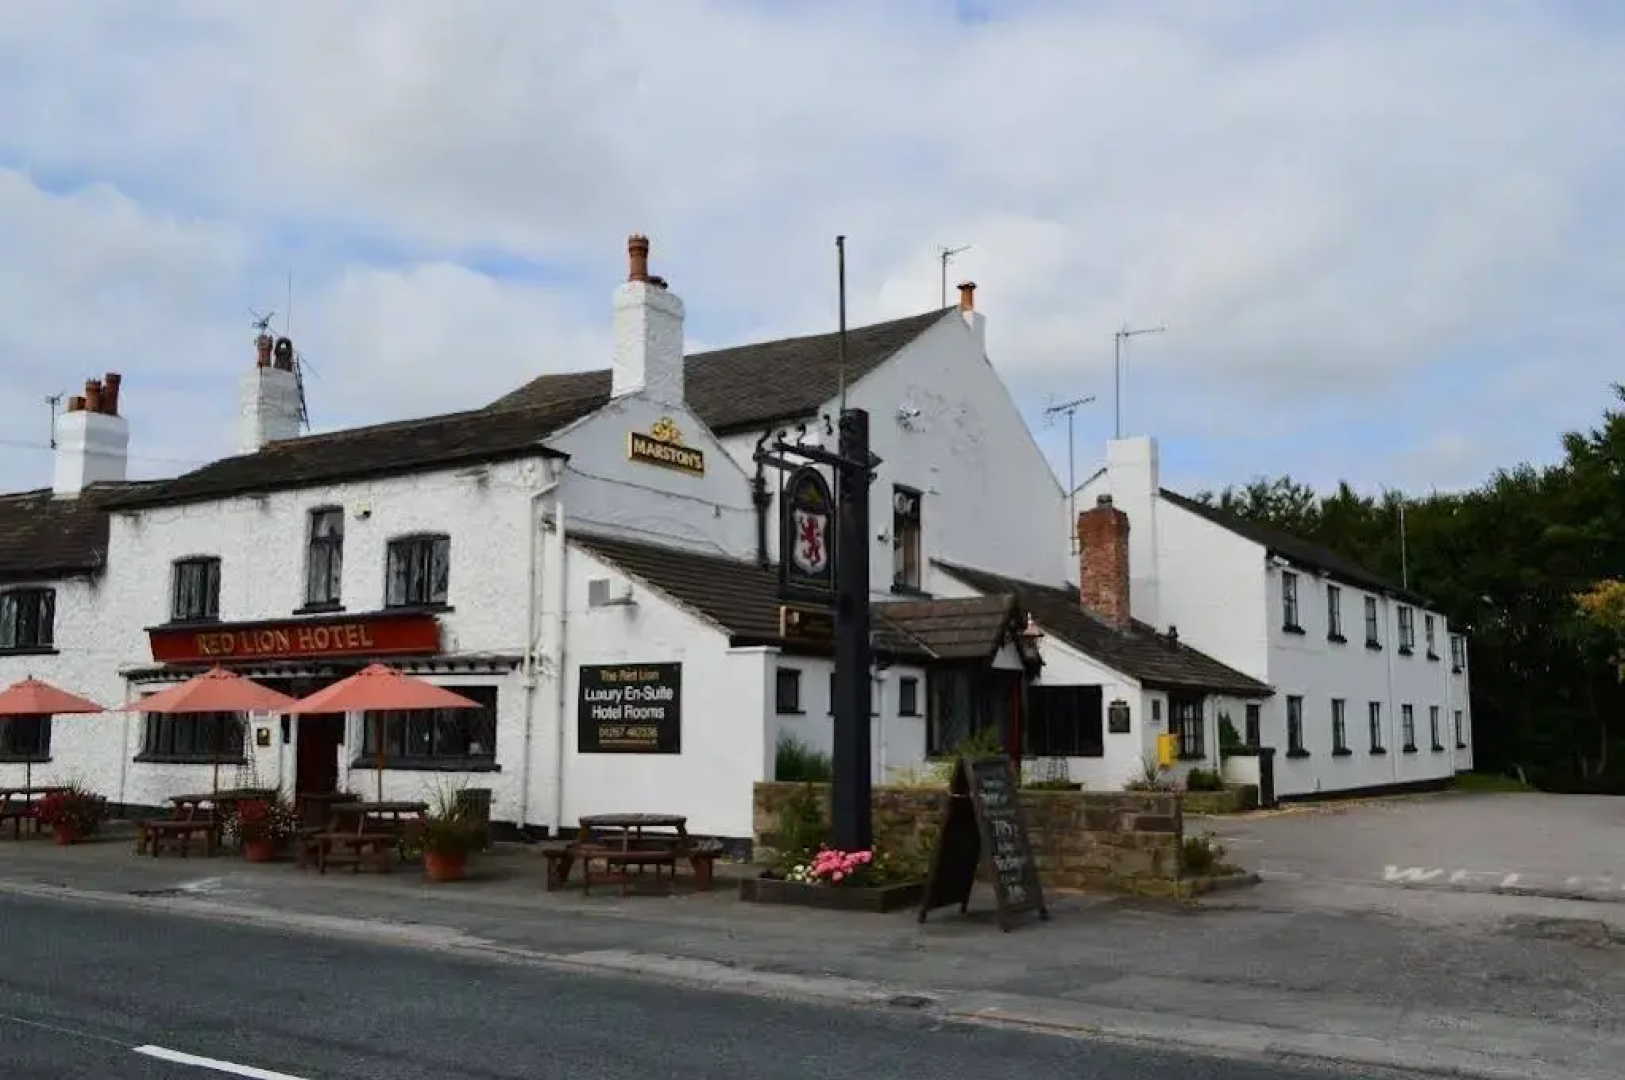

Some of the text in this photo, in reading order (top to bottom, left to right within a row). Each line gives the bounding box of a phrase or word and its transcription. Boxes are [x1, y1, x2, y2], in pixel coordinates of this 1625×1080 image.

[196, 624, 375, 655] RED LION HOTEL
[600, 669, 617, 681] The
[584, 685, 674, 703] Luxury En-Suite
[592, 704, 665, 719] Hotel Rooms
